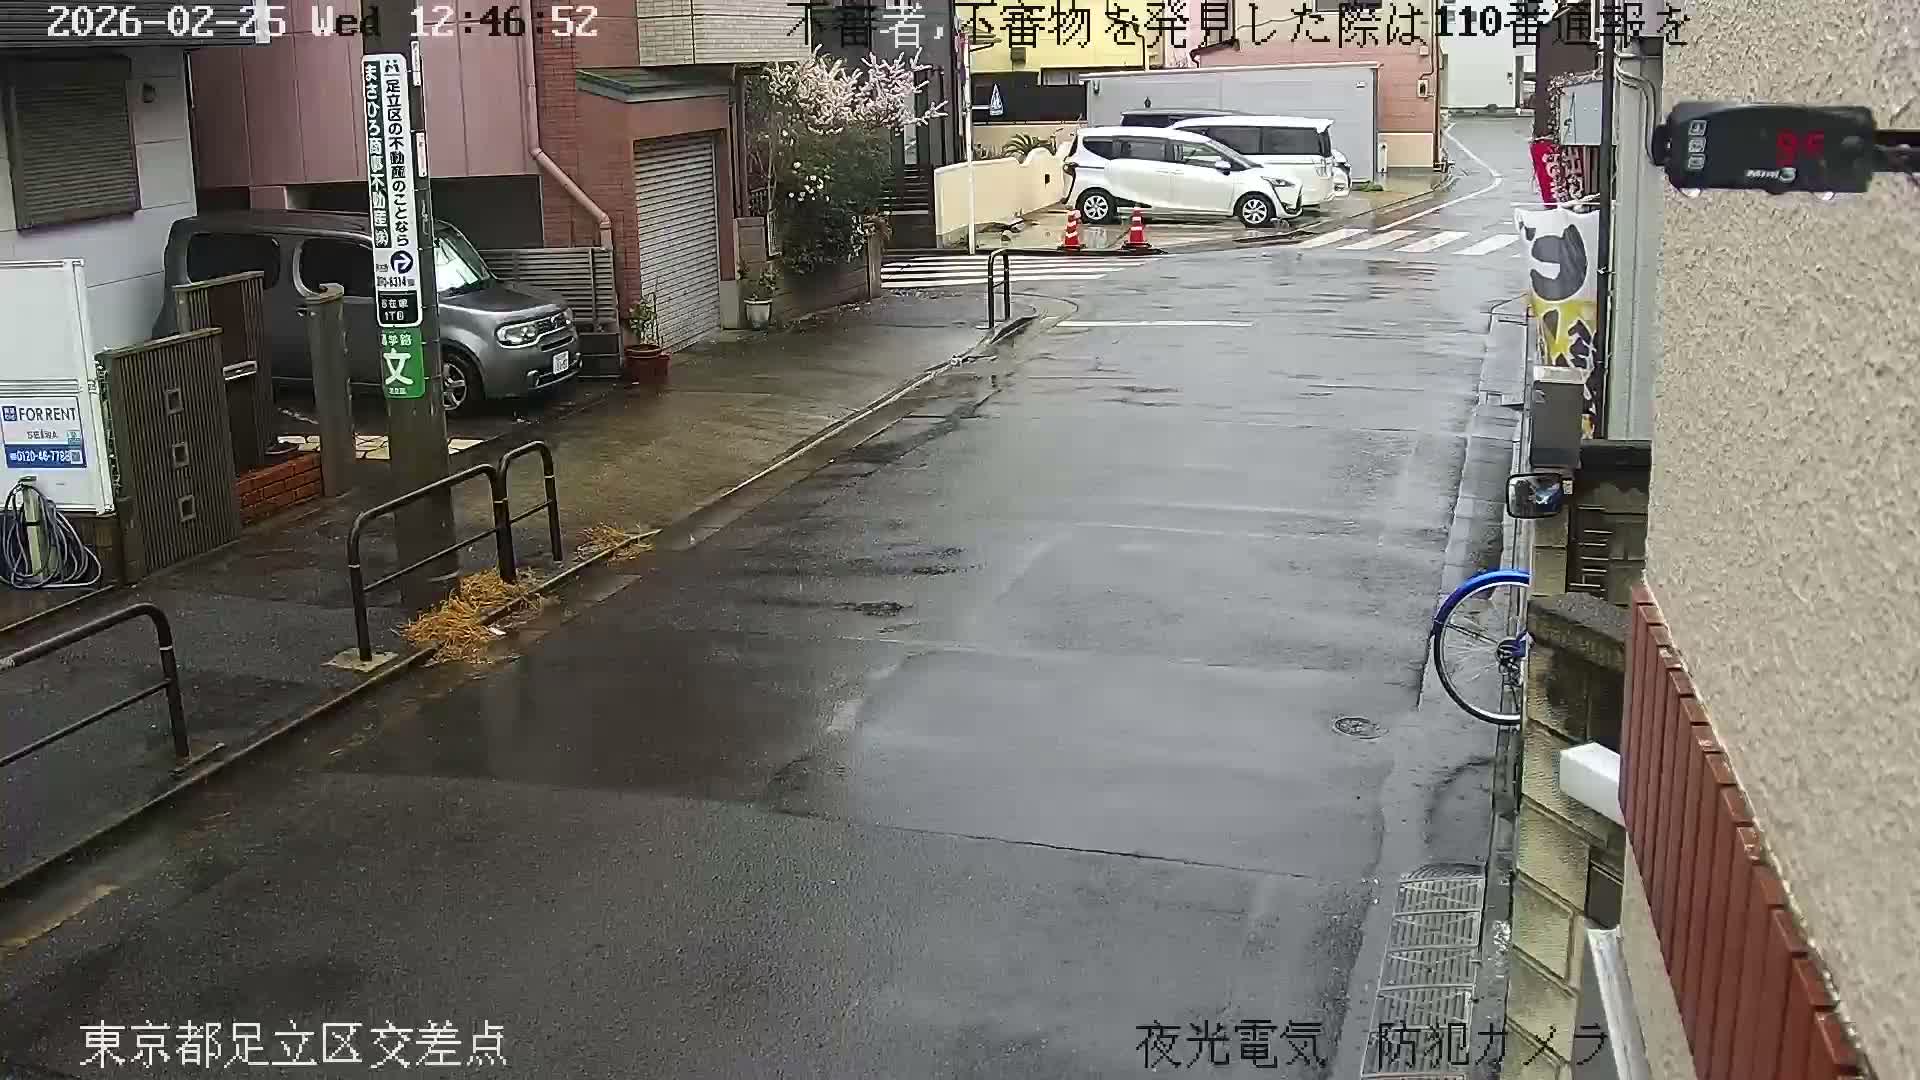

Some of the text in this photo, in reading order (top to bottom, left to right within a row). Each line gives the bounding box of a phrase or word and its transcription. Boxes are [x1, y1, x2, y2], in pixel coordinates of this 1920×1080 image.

[383, 347, 414, 385] 文
[19, 407, 76, 421] FOR RENT
